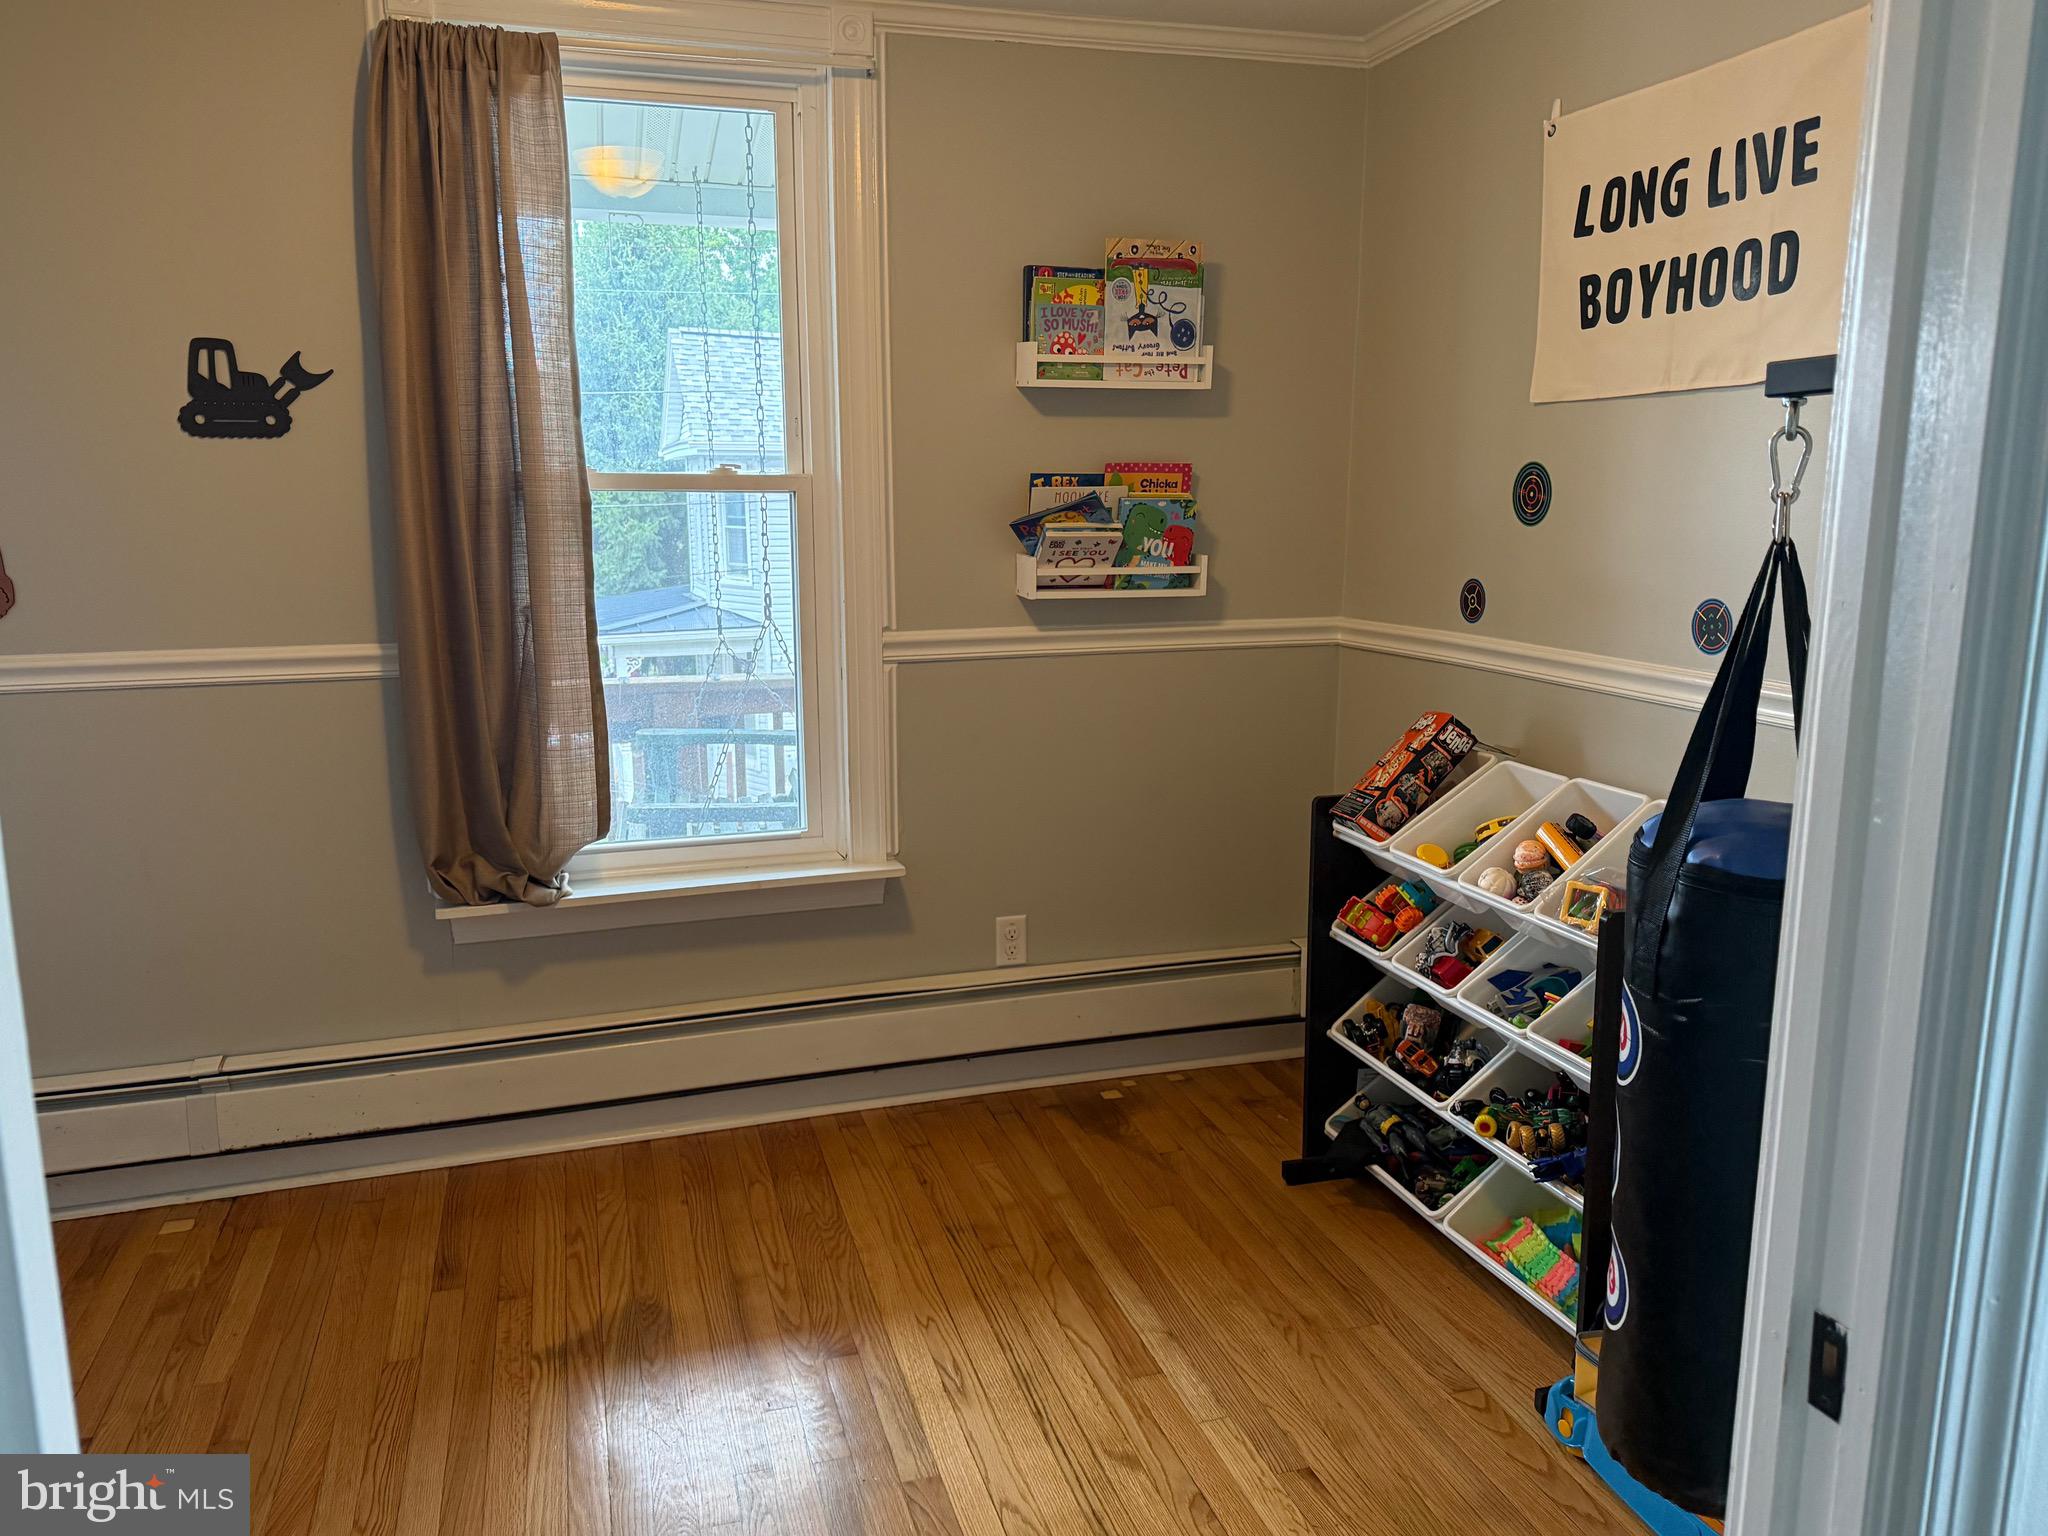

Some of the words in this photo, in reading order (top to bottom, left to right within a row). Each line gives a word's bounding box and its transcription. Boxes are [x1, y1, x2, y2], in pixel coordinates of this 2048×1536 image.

[1573, 157, 1690, 239] LONG
[1707, 115, 1821, 209] LIVE
[1579, 229, 1800, 331] BOYHOOD
[1040, 307, 1047, 318] I
[1050, 307, 1078, 318] LOVE
[1044, 319, 1061, 332] SO
[1062, 319, 1098, 333] MUSH!
[1112, 344, 1136, 353] Buttons
[1137, 342, 1161, 352] Groovy
[1116, 363, 1143, 379] Cat
[1155, 363, 1188, 379] Pete
[1140, 477, 1178, 489] Chicka
[1082, 549, 1107, 557] YOU
[1143, 536, 1175, 558] YOU
[1438, 723, 1475, 755] Jenga
